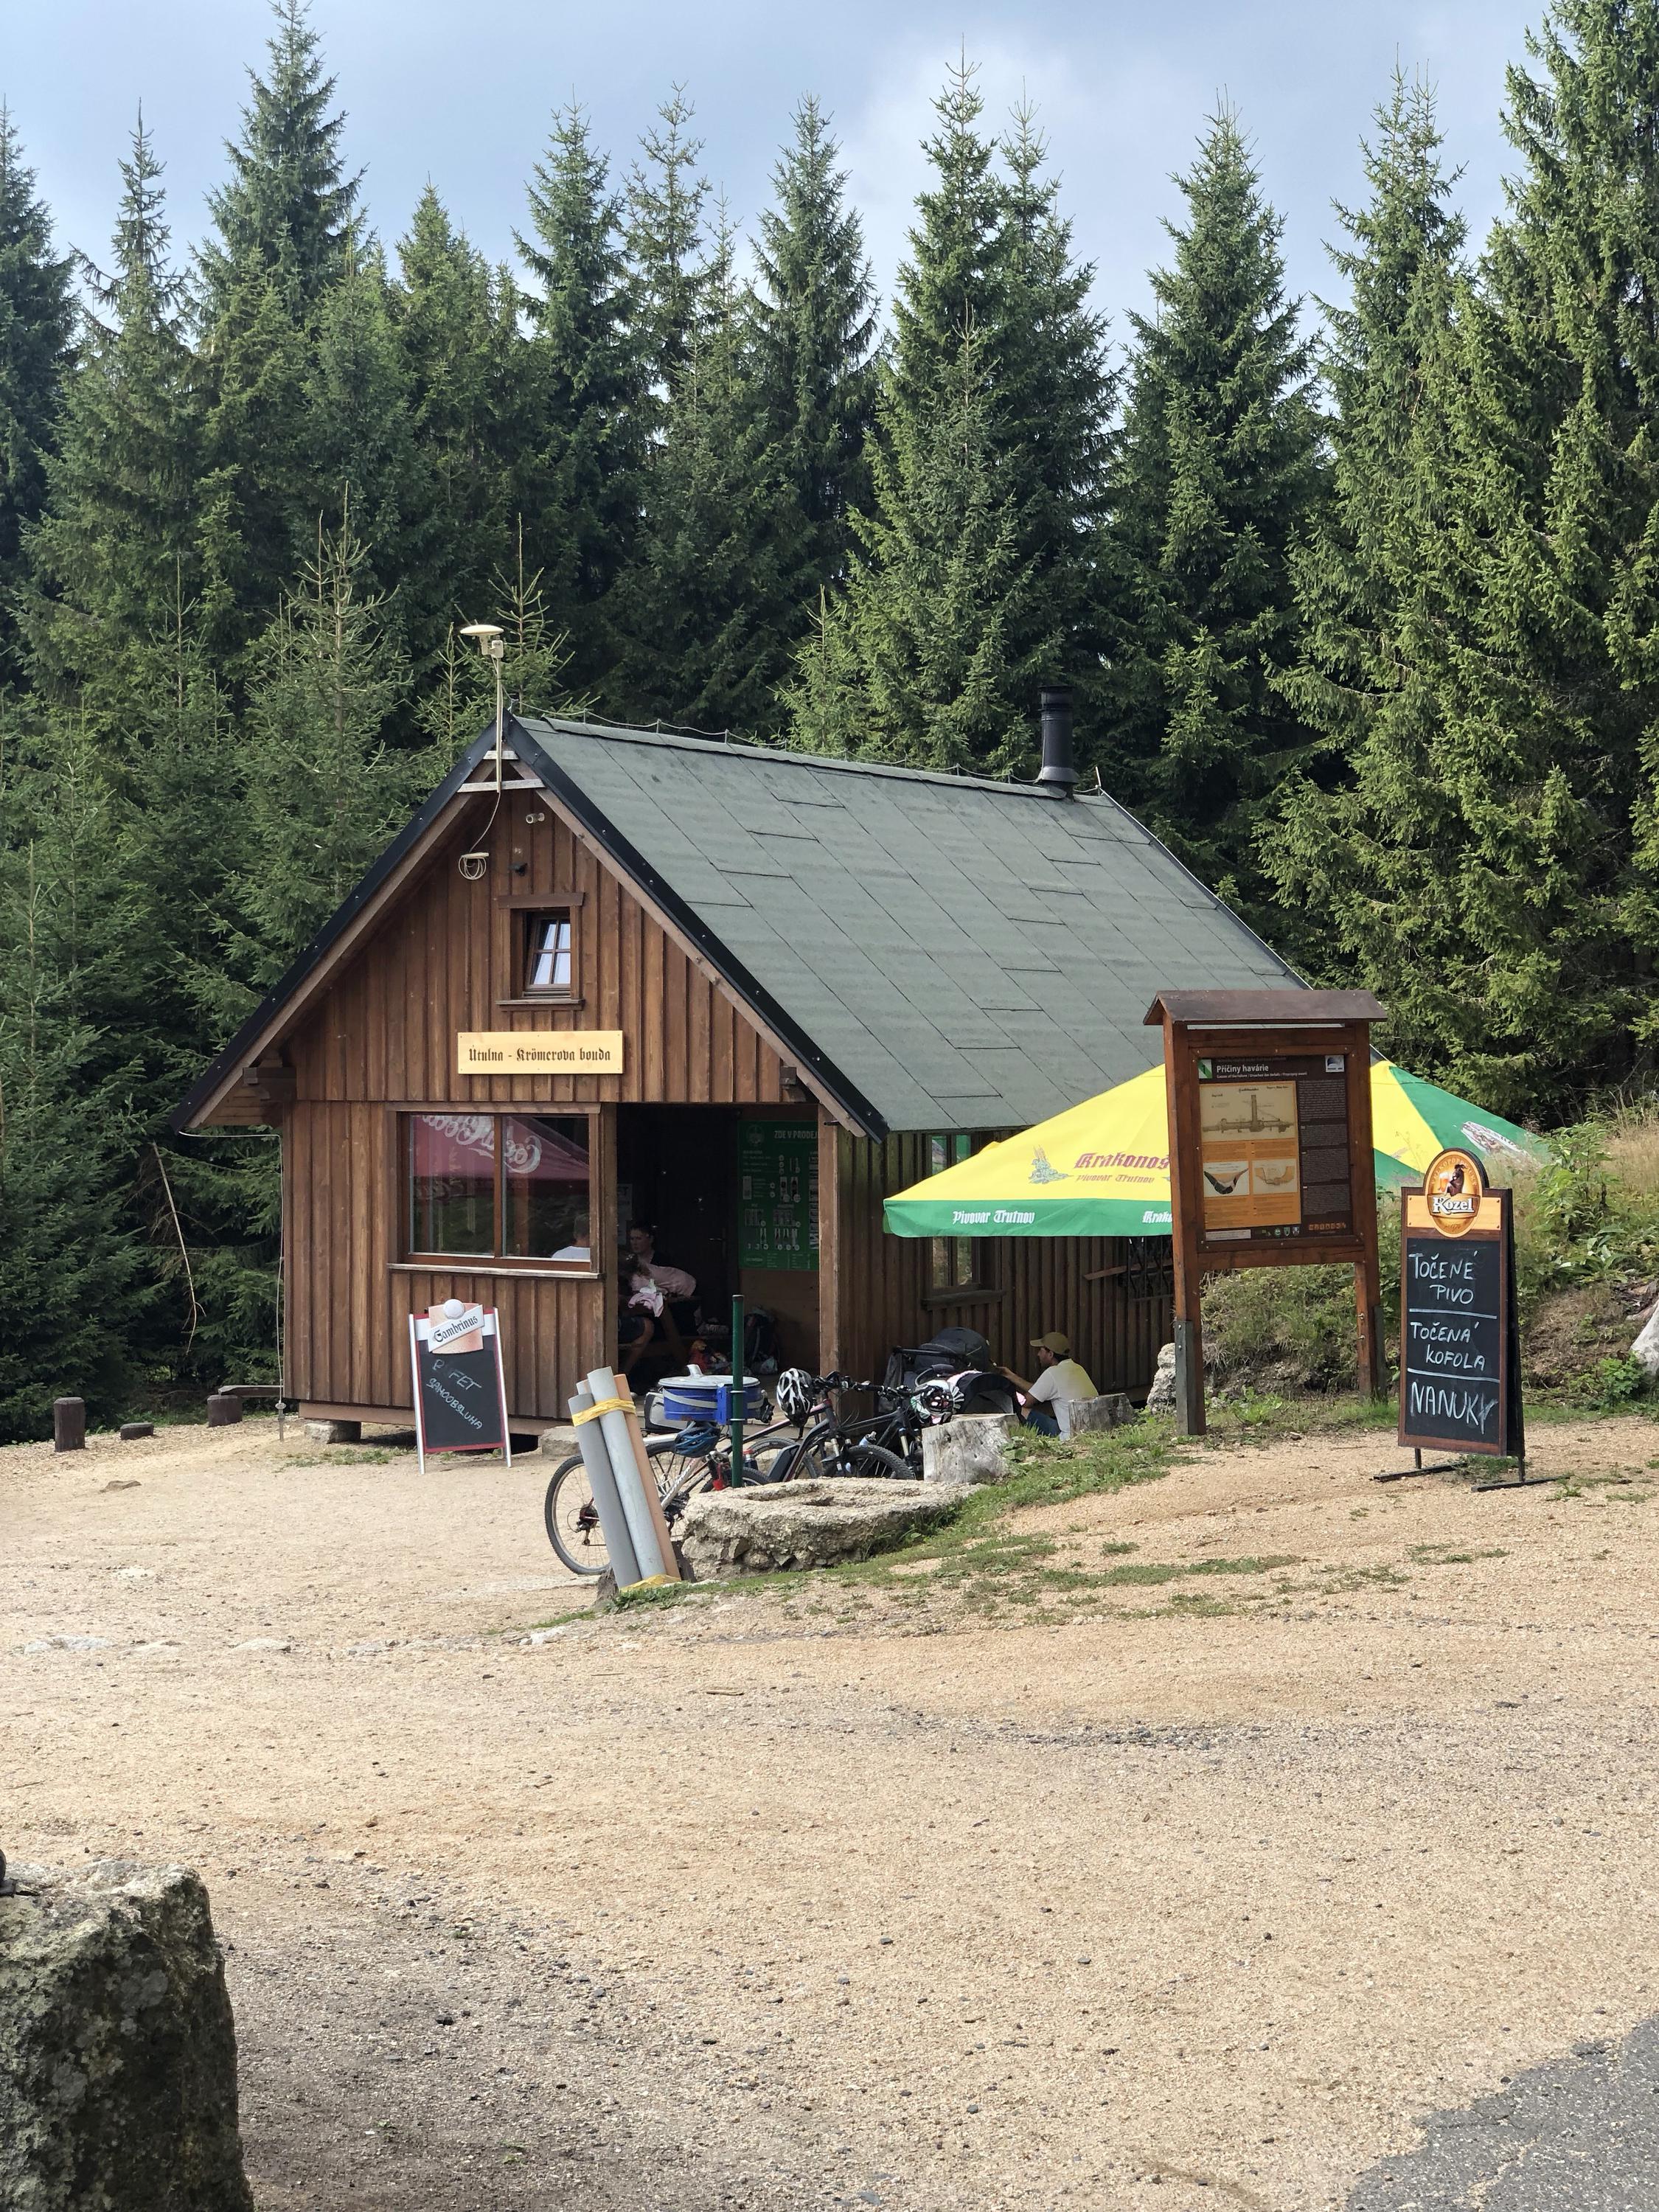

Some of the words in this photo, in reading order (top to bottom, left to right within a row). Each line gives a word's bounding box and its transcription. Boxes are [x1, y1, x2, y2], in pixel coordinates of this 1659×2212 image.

[469, 1044, 504, 1062] Útulna
[516, 1047, 575, 1062] Krömerova
[580, 1047, 611, 1061] bouda
[1217, 1064, 1240, 1074] Příčiny
[1242, 1063, 1269, 1072] havárie
[774, 1130, 786, 1139] ZDE
[787, 1130, 792, 1139] V
[1116, 1174, 1155, 1183] Trutnov
[1433, 1197, 1475, 1214] Kozel
[952, 1211, 991, 1225] Pivovar
[994, 1209, 1035, 1224] Trutnov
[1408, 1251, 1478, 1280] TOČENÉ
[1429, 1284, 1474, 1304] PIVO
[434, 1315, 479, 1342] Gambrinus
[1410, 1321, 1480, 1343] TOČENÁ
[1425, 1344, 1486, 1371] KOFOLA
[425, 1377, 483, 1430] SAMOOBSLUHA
[1410, 1380, 1499, 1435] NANUKY
